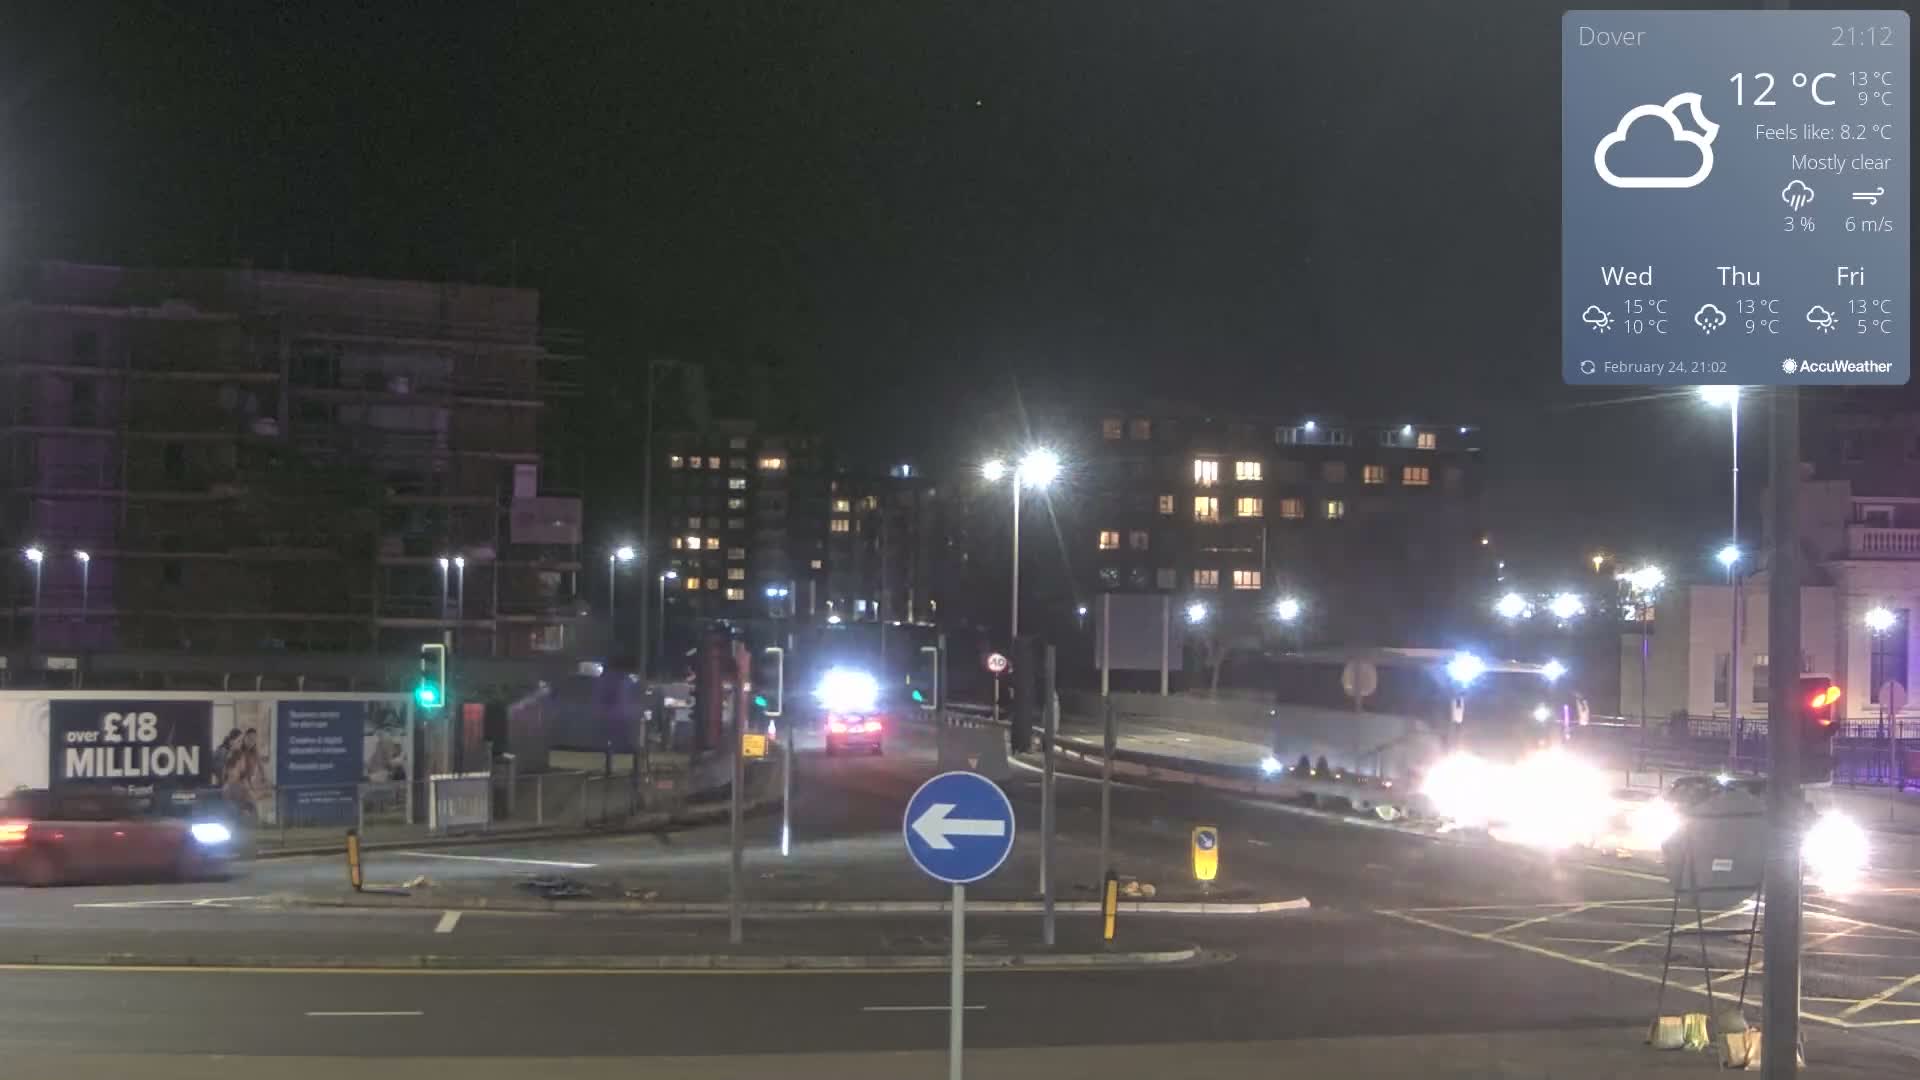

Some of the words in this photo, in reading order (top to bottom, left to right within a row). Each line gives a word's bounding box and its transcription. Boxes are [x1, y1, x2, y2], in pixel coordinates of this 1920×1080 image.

[66, 730, 99, 743] over
[103, 712, 158, 743] £18
[65, 746, 200, 778] MILLION
